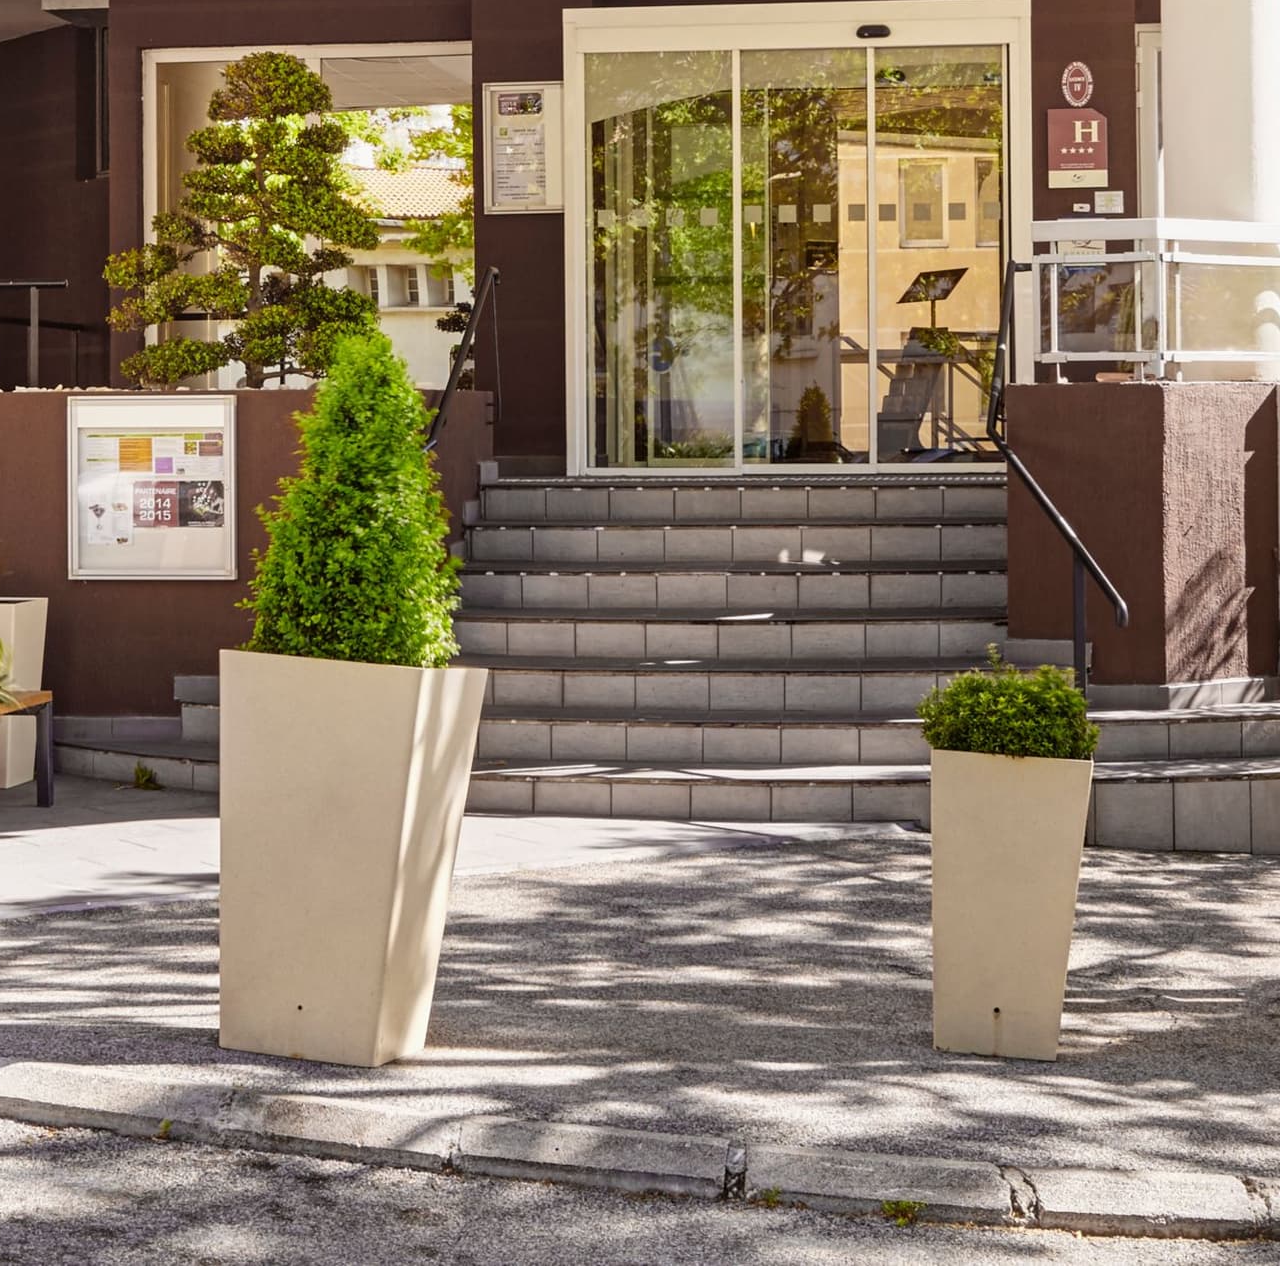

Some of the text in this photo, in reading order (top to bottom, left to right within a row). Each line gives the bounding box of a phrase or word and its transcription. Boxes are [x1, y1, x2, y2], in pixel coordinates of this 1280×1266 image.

[1072, 120, 1101, 143] H
[134, 487, 177, 495] PARTENAIRE
[139, 498, 171, 509] 2014
[139, 510, 171, 521] 2015
